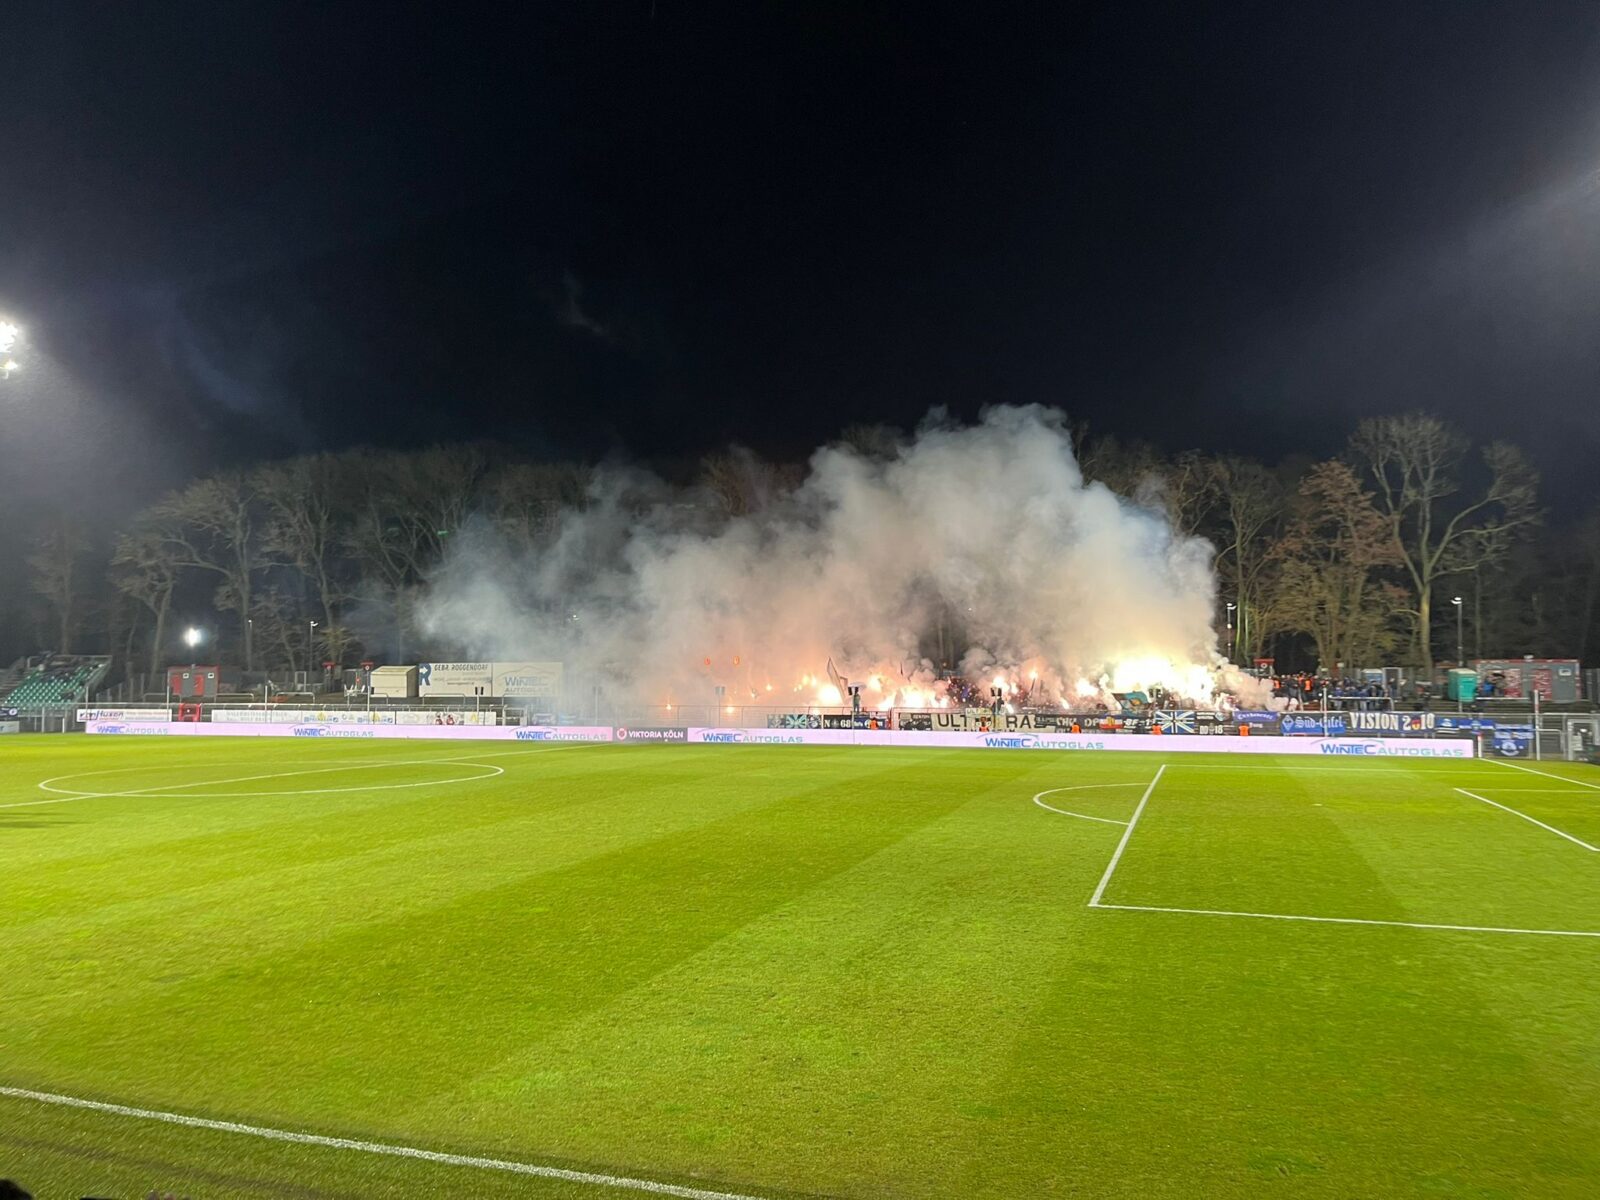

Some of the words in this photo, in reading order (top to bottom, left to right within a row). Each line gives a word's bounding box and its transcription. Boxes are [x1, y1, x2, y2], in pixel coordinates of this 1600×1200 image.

[1350, 712, 1399, 730] VISION
[628, 730, 662, 738] VIKTORIA
[663, 728, 684, 738] KÖLN
[743, 735, 803, 743] AUTOGLAS
[1033, 741, 1105, 749] AUTOGLAS
[1376, 748, 1463, 757] AUTOGLAS
